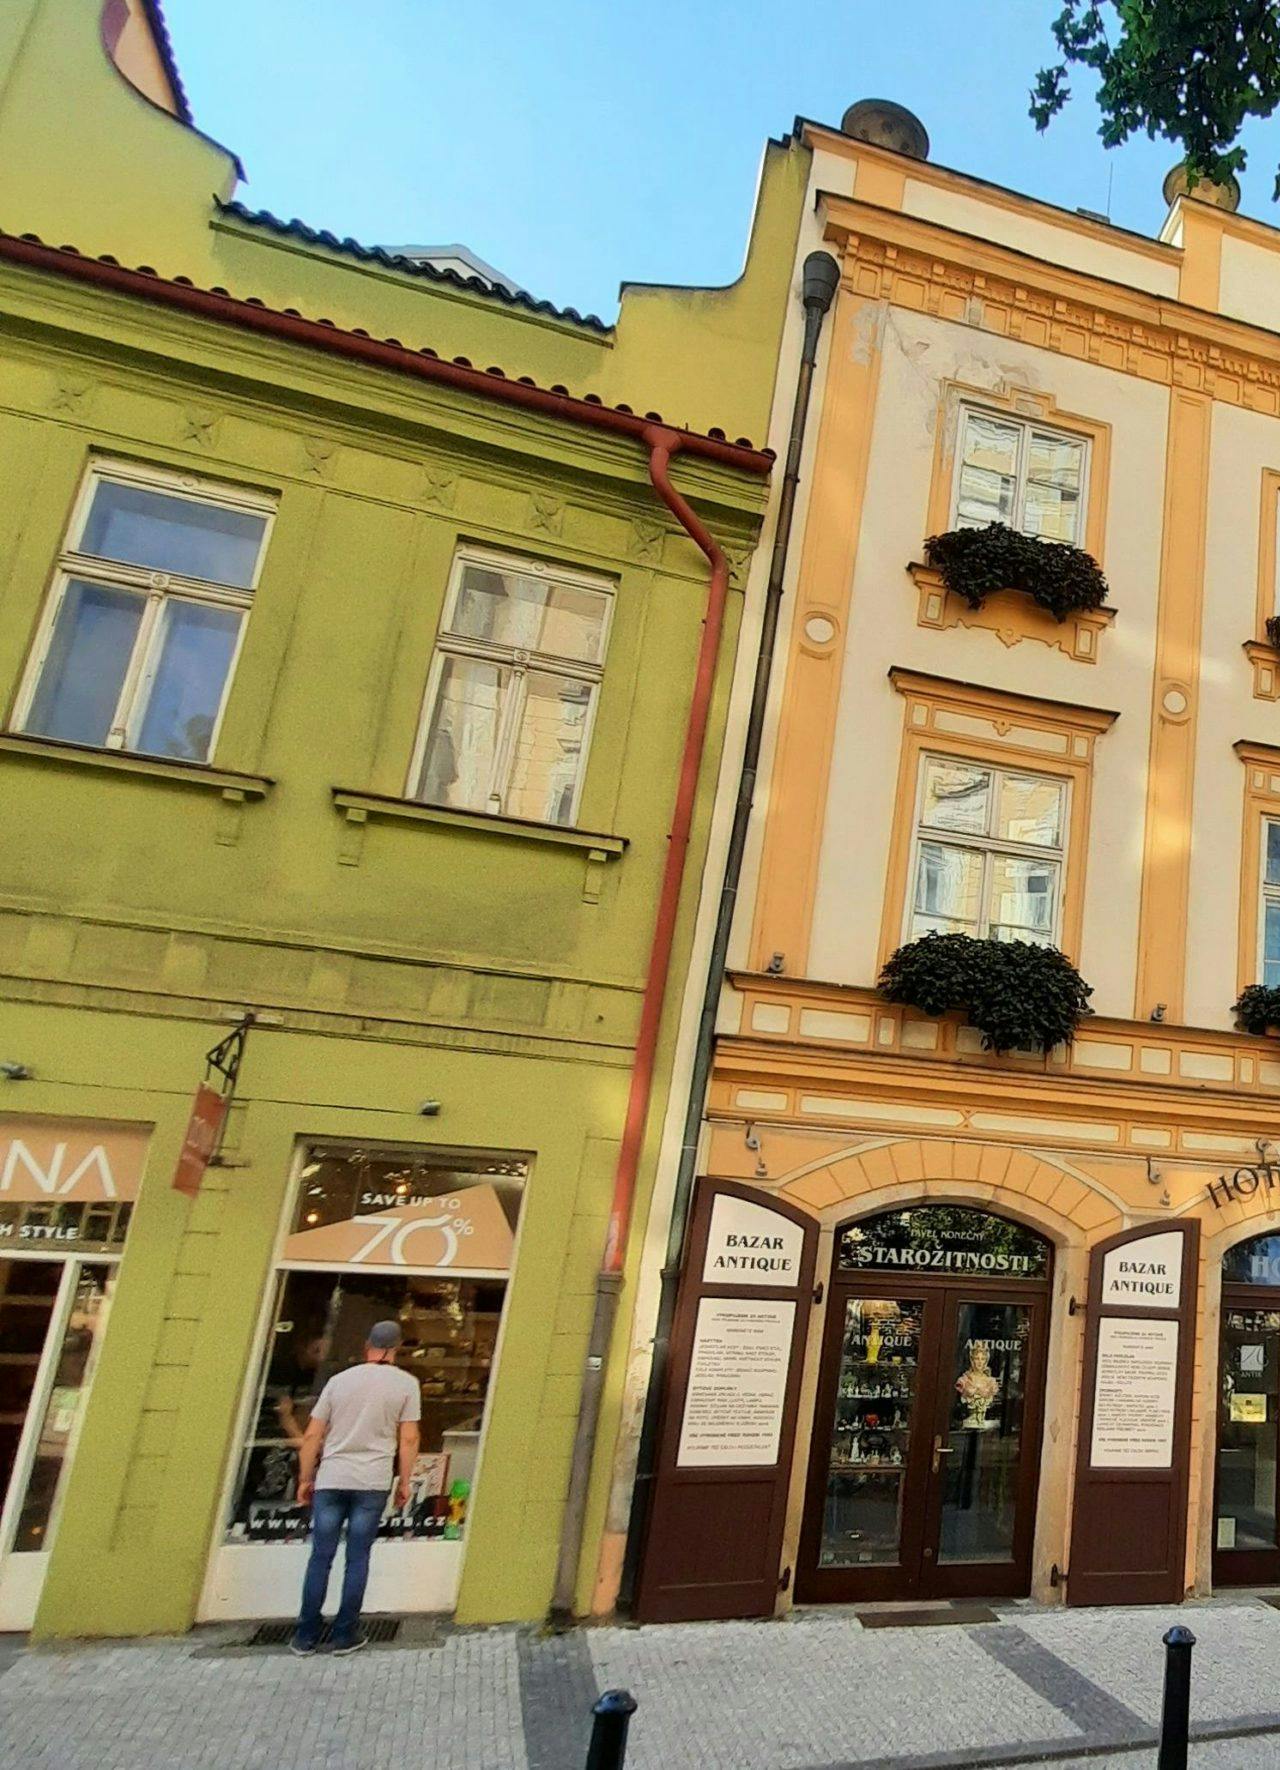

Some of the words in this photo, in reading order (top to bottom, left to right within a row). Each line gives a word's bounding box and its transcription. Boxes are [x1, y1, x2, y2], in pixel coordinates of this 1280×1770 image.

[361, 1192, 406, 1206] SAVE
[410, 1196, 432, 1208] UP
[439, 1198, 461, 1209] TO
[19, 1225, 80, 1239] STYLE
[726, 1234, 784, 1250] BAZAR
[713, 1255, 793, 1272] ANTIQUE
[859, 1240, 1029, 1272] STAROŽITNOSTI
[1119, 1261, 1167, 1275] BAZAR
[1110, 1280, 1175, 1295] ANTIQUE
[964, 1338, 1022, 1350] ANTIQUE
